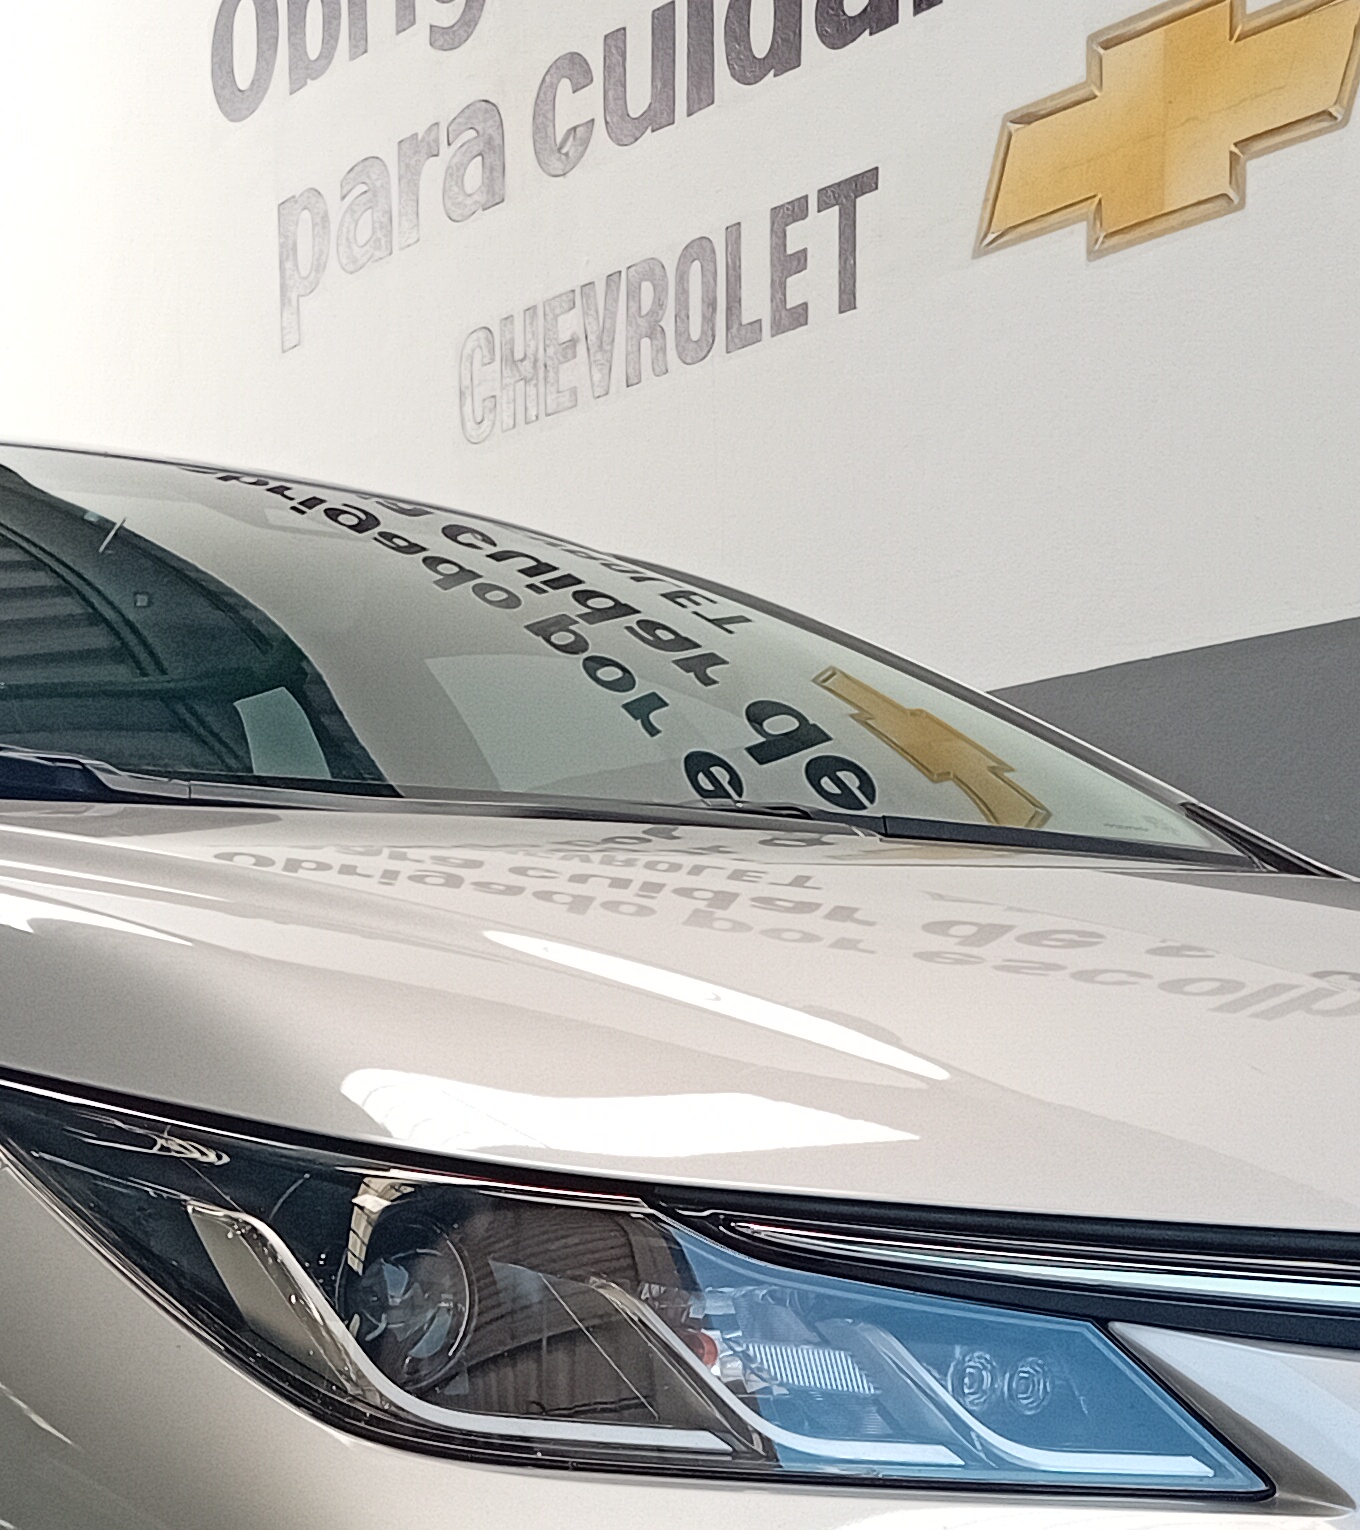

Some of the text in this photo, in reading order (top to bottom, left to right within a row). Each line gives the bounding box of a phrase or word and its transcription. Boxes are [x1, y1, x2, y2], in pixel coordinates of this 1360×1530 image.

[211, 0, 487, 122] Obr
[277, 0, 944, 354] para cuid
[457, 166, 880, 445] CHEVROLET
